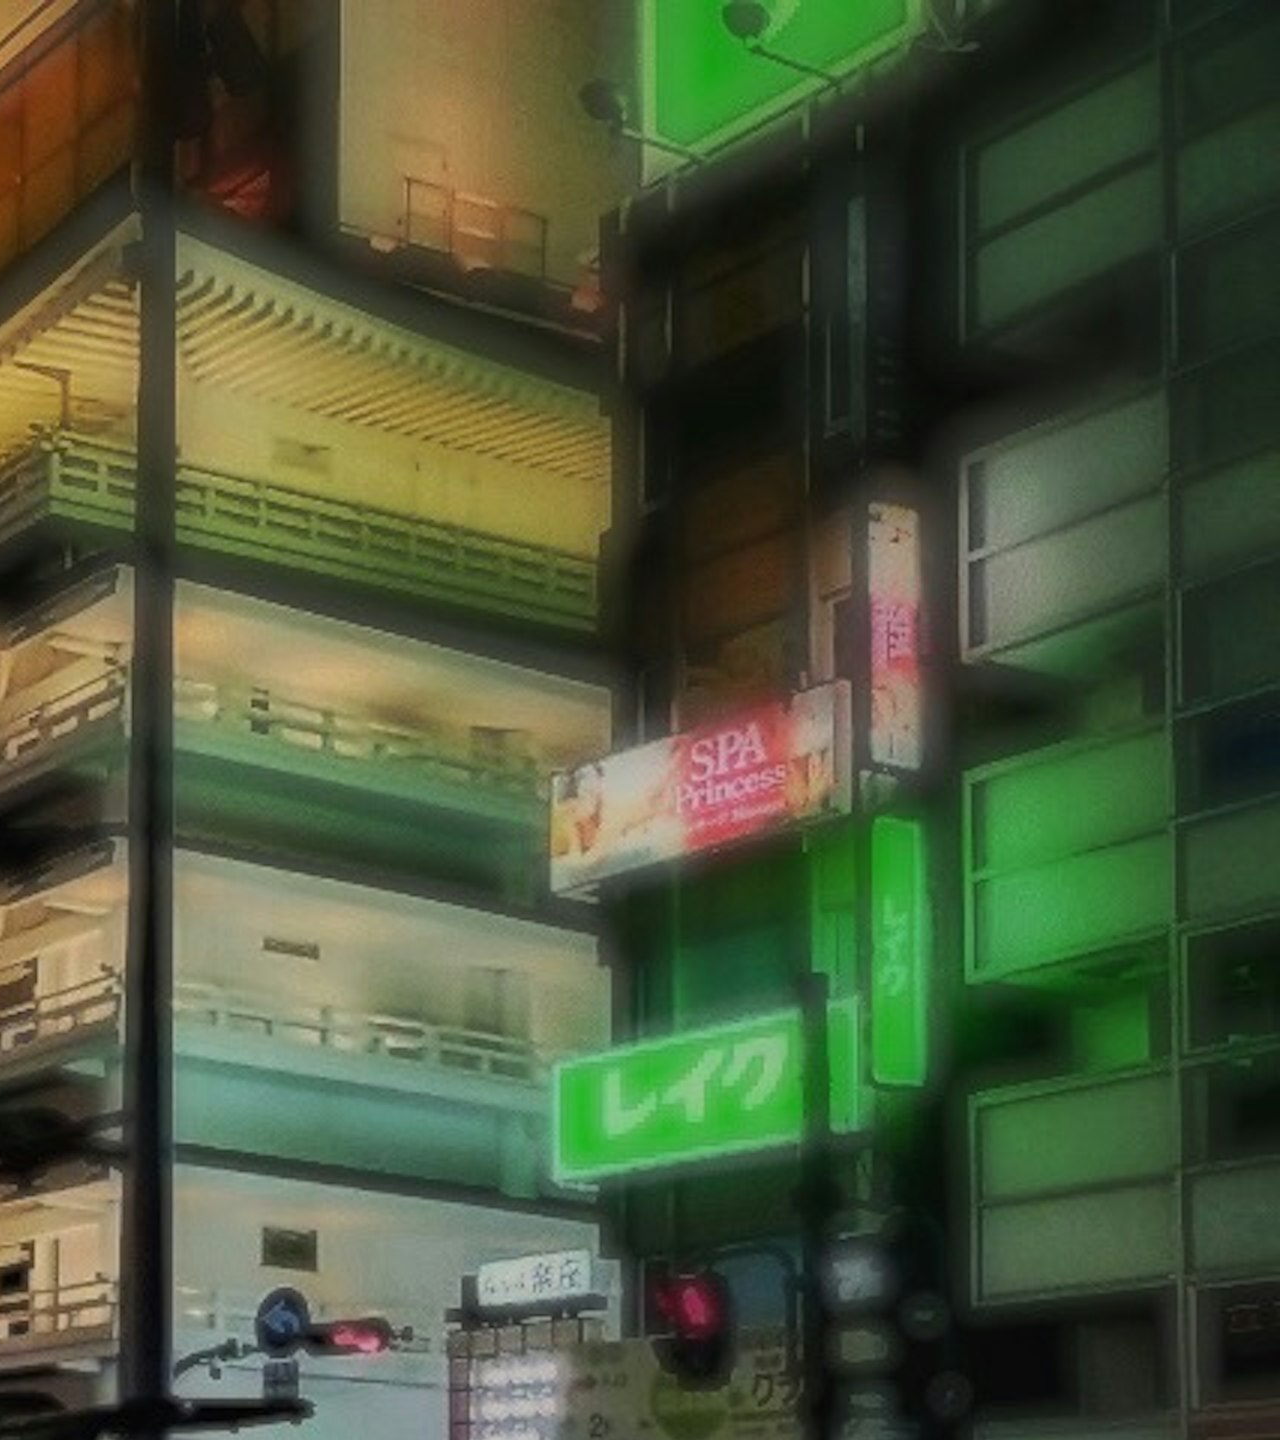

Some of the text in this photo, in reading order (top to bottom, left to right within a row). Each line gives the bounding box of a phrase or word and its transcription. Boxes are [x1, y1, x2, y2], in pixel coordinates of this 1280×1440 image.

[691, 722, 768, 781] SPA
[675, 764, 787, 814] Princess
[606, 1034, 789, 1137] レイク
